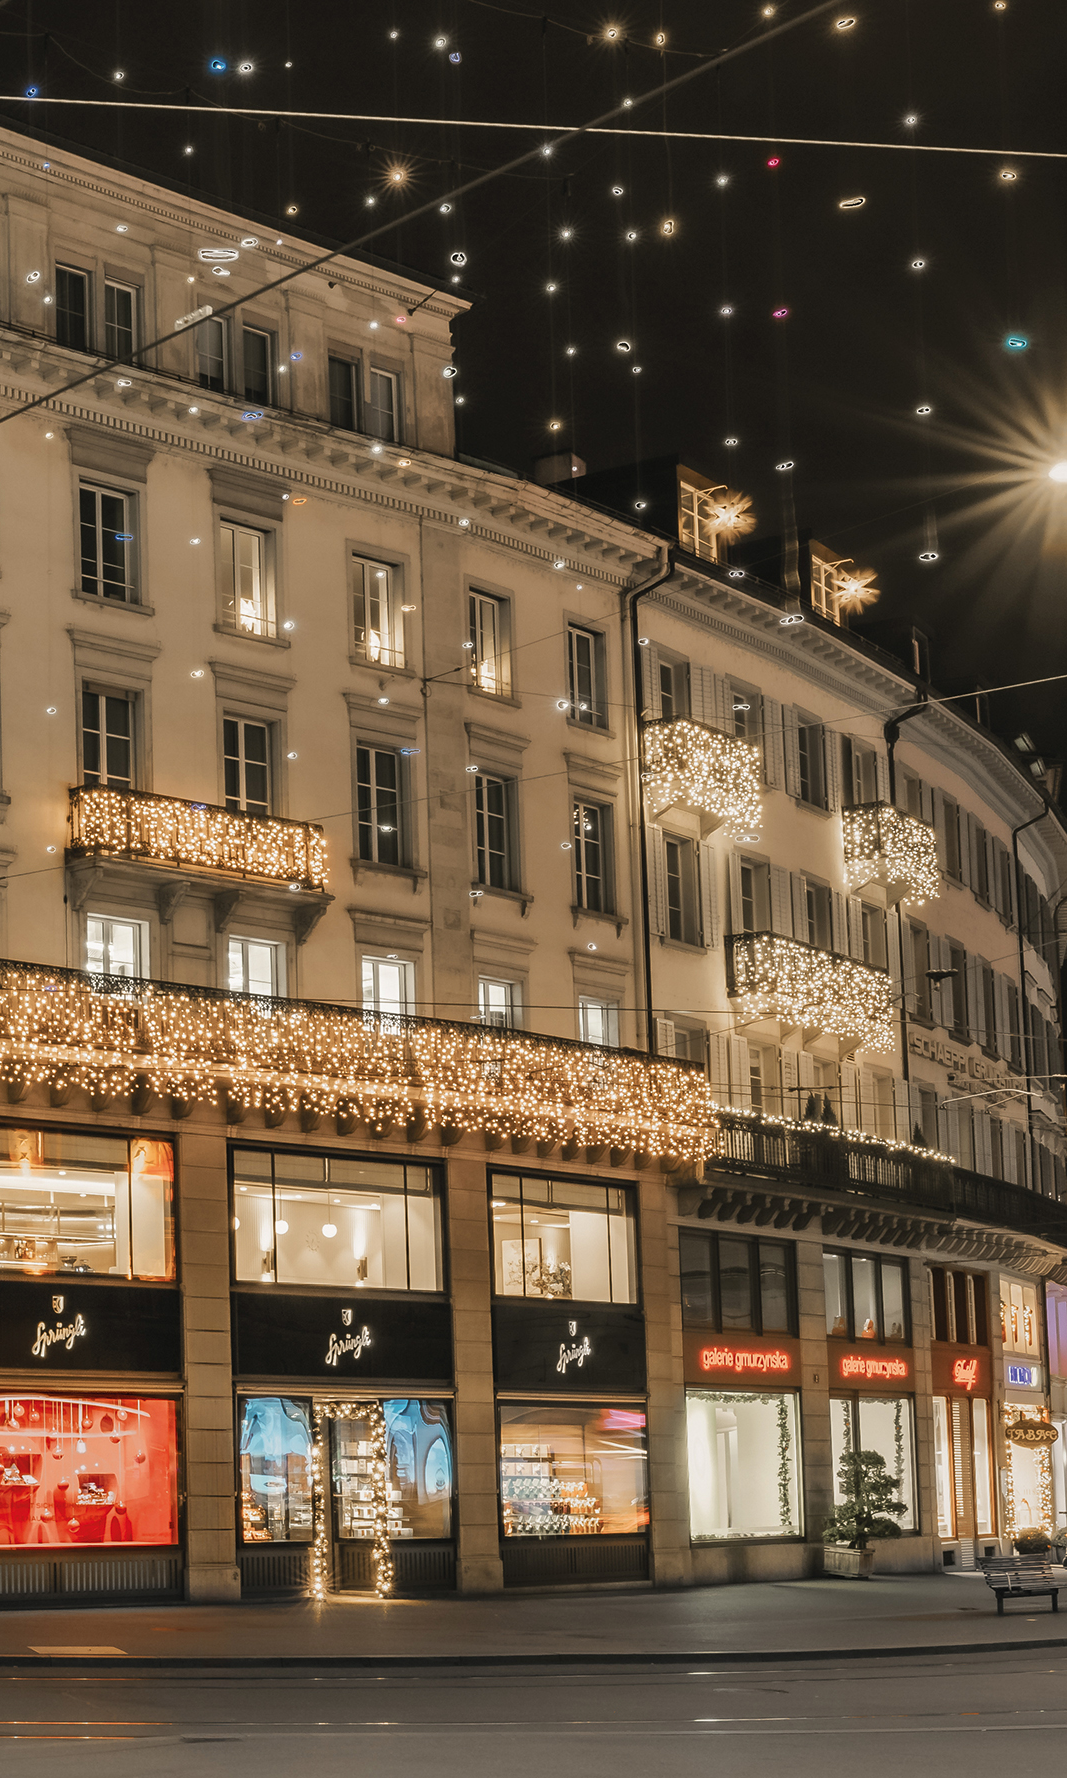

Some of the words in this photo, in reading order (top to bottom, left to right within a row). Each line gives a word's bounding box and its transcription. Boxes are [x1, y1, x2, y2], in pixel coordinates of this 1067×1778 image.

[32, 1313, 86, 1358] Sprüngli
[703, 1348, 734, 1369] galerie
[735, 1351, 789, 1372] gmurzynska
[842, 1356, 866, 1376] galerie
[865, 1359, 906, 1378] gmurzynska
[1006, 1428, 1058, 1441] TABAC
